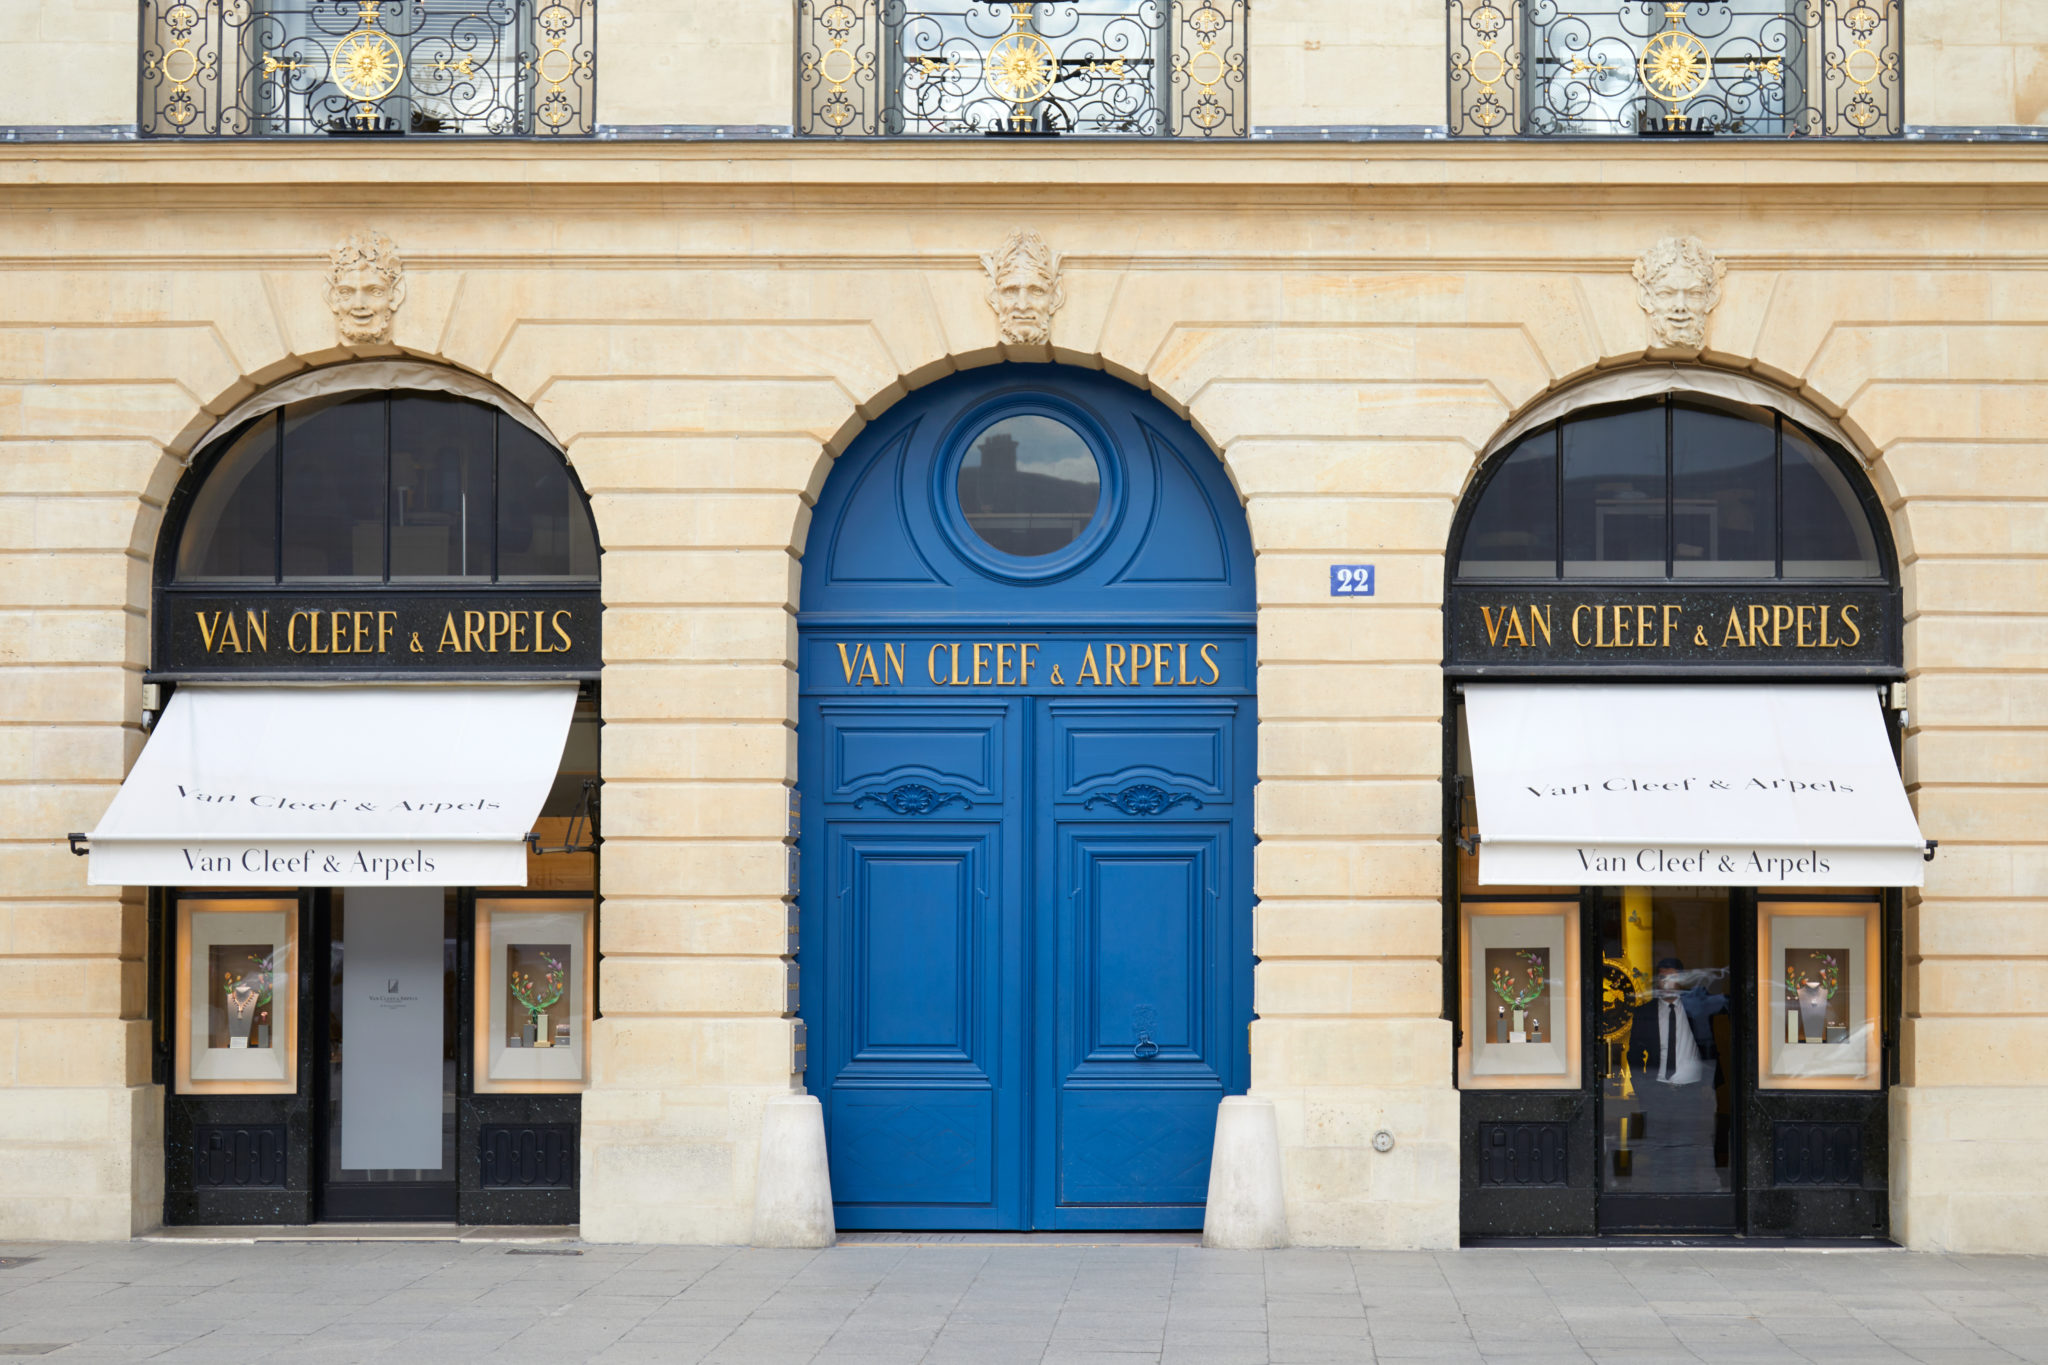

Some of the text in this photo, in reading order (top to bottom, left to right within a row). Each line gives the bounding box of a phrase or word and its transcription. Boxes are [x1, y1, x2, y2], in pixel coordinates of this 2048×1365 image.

[1336, 568, 1369, 593] 22
[195, 609, 573, 654] VAN CLEEF & ARPELS
[1479, 604, 1861, 648] VAN CLEEF & ARPELS
[836, 642, 1221, 687] VAN CLEEF & ARPELS
[176, 785, 501, 814] Van Cleef & Arpels
[1526, 777, 1855, 798] Van Cleef & Arpels
[182, 848, 436, 881] Van Cleef & Arpels
[1576, 849, 1831, 880] Van Cleef & Arpels
